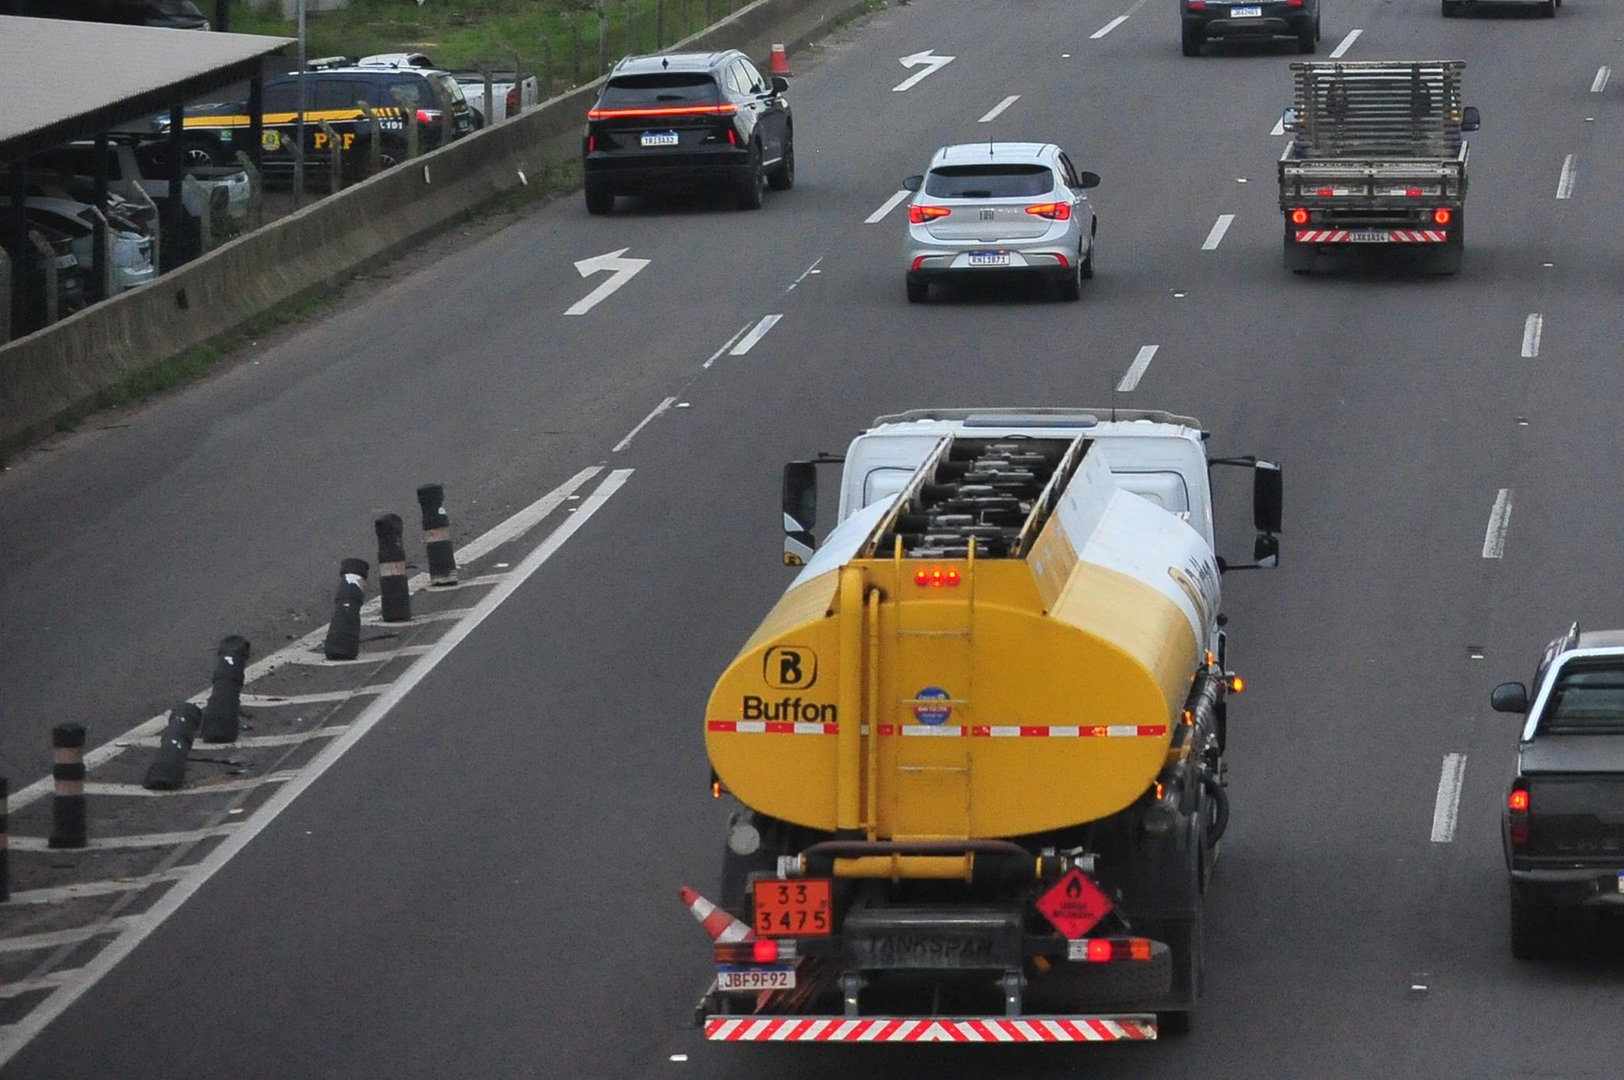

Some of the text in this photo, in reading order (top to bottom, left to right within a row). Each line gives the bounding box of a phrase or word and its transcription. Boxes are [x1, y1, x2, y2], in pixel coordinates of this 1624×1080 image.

[742, 695, 838, 722] Buffon
[778, 885, 808, 905] 33
[761, 910, 826, 931] 3475
[724, 972, 788, 988] JBF9F92
